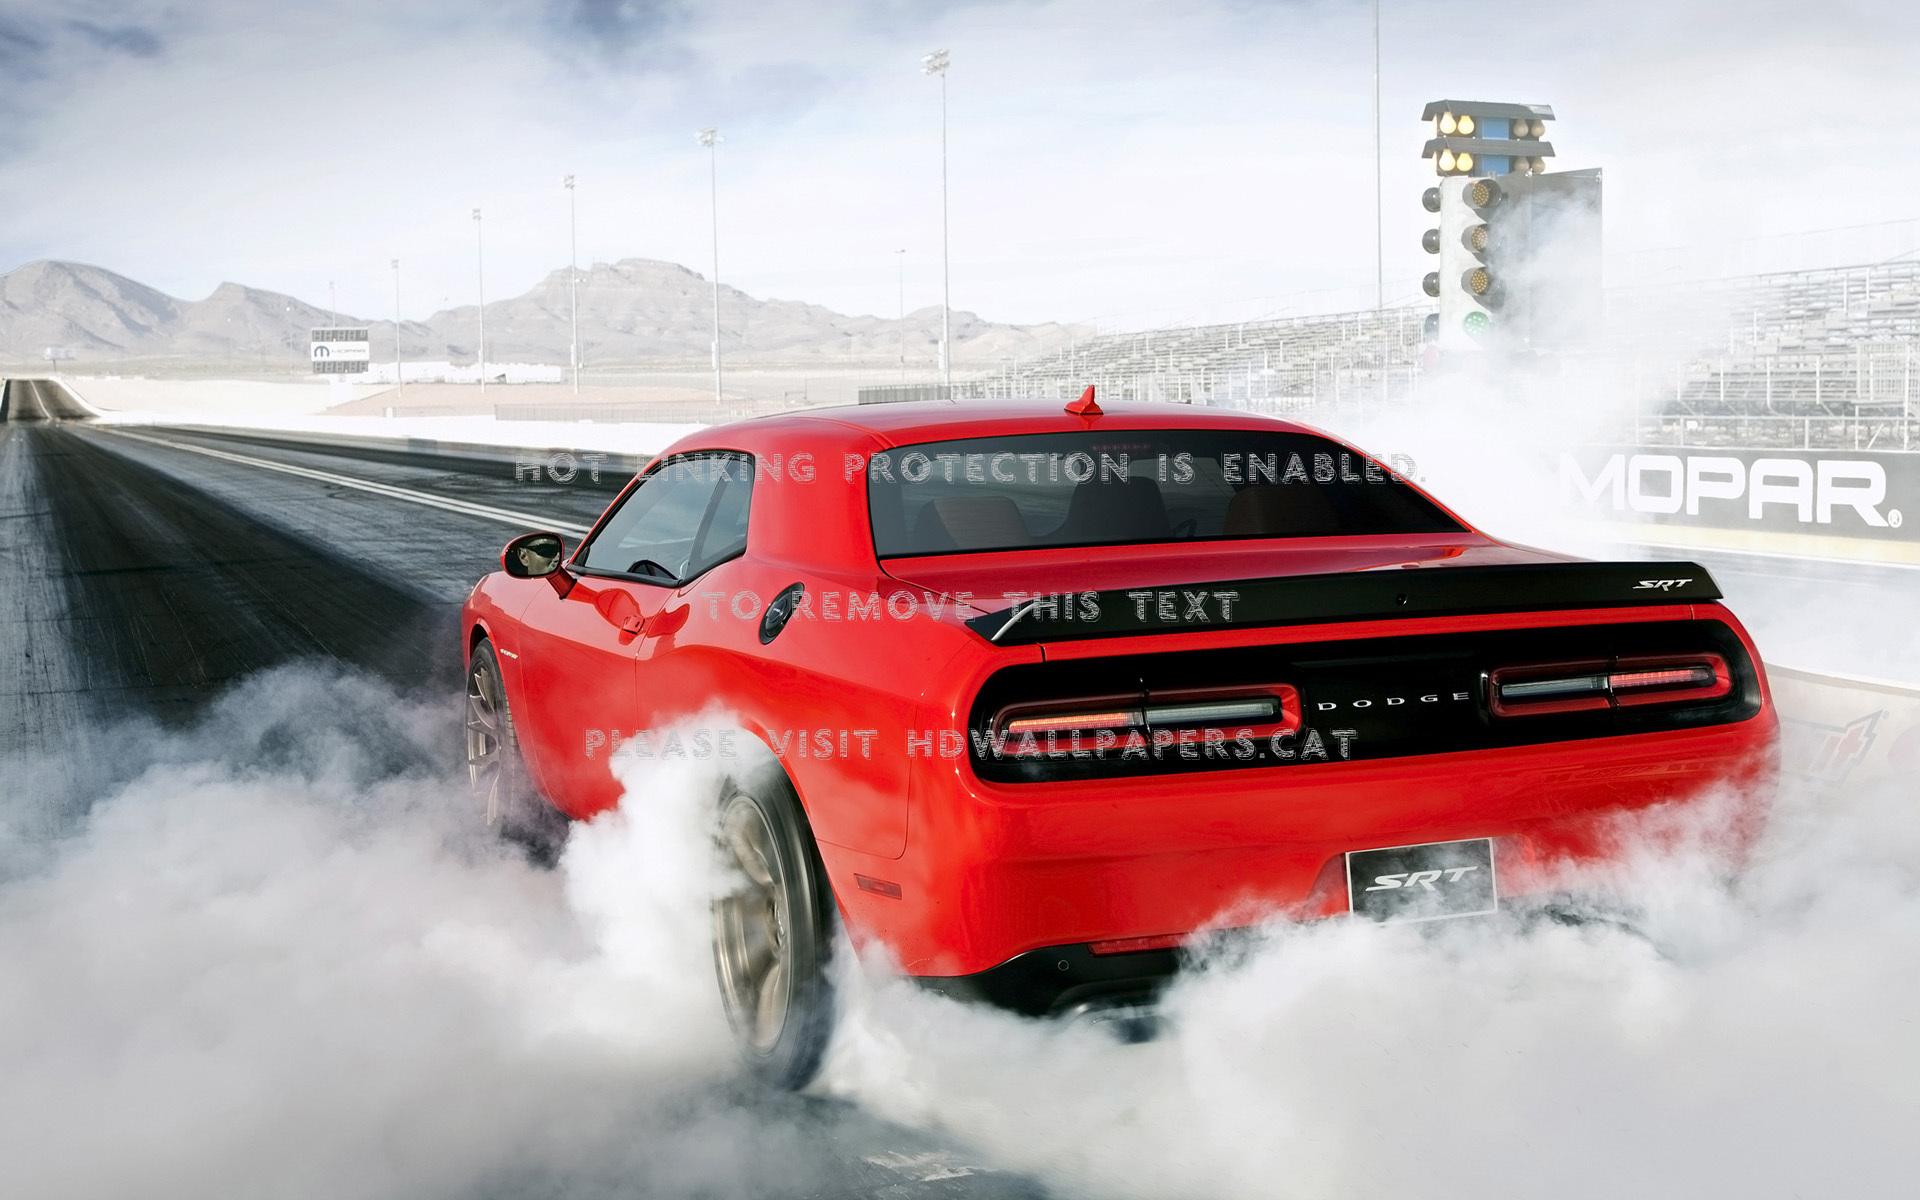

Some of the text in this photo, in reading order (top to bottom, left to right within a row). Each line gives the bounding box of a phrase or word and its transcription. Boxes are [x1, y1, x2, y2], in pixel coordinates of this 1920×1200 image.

[1632, 578, 1693, 592] SRT
[1318, 692, 1470, 711] DODGE
[1365, 865, 1479, 892] SRT
